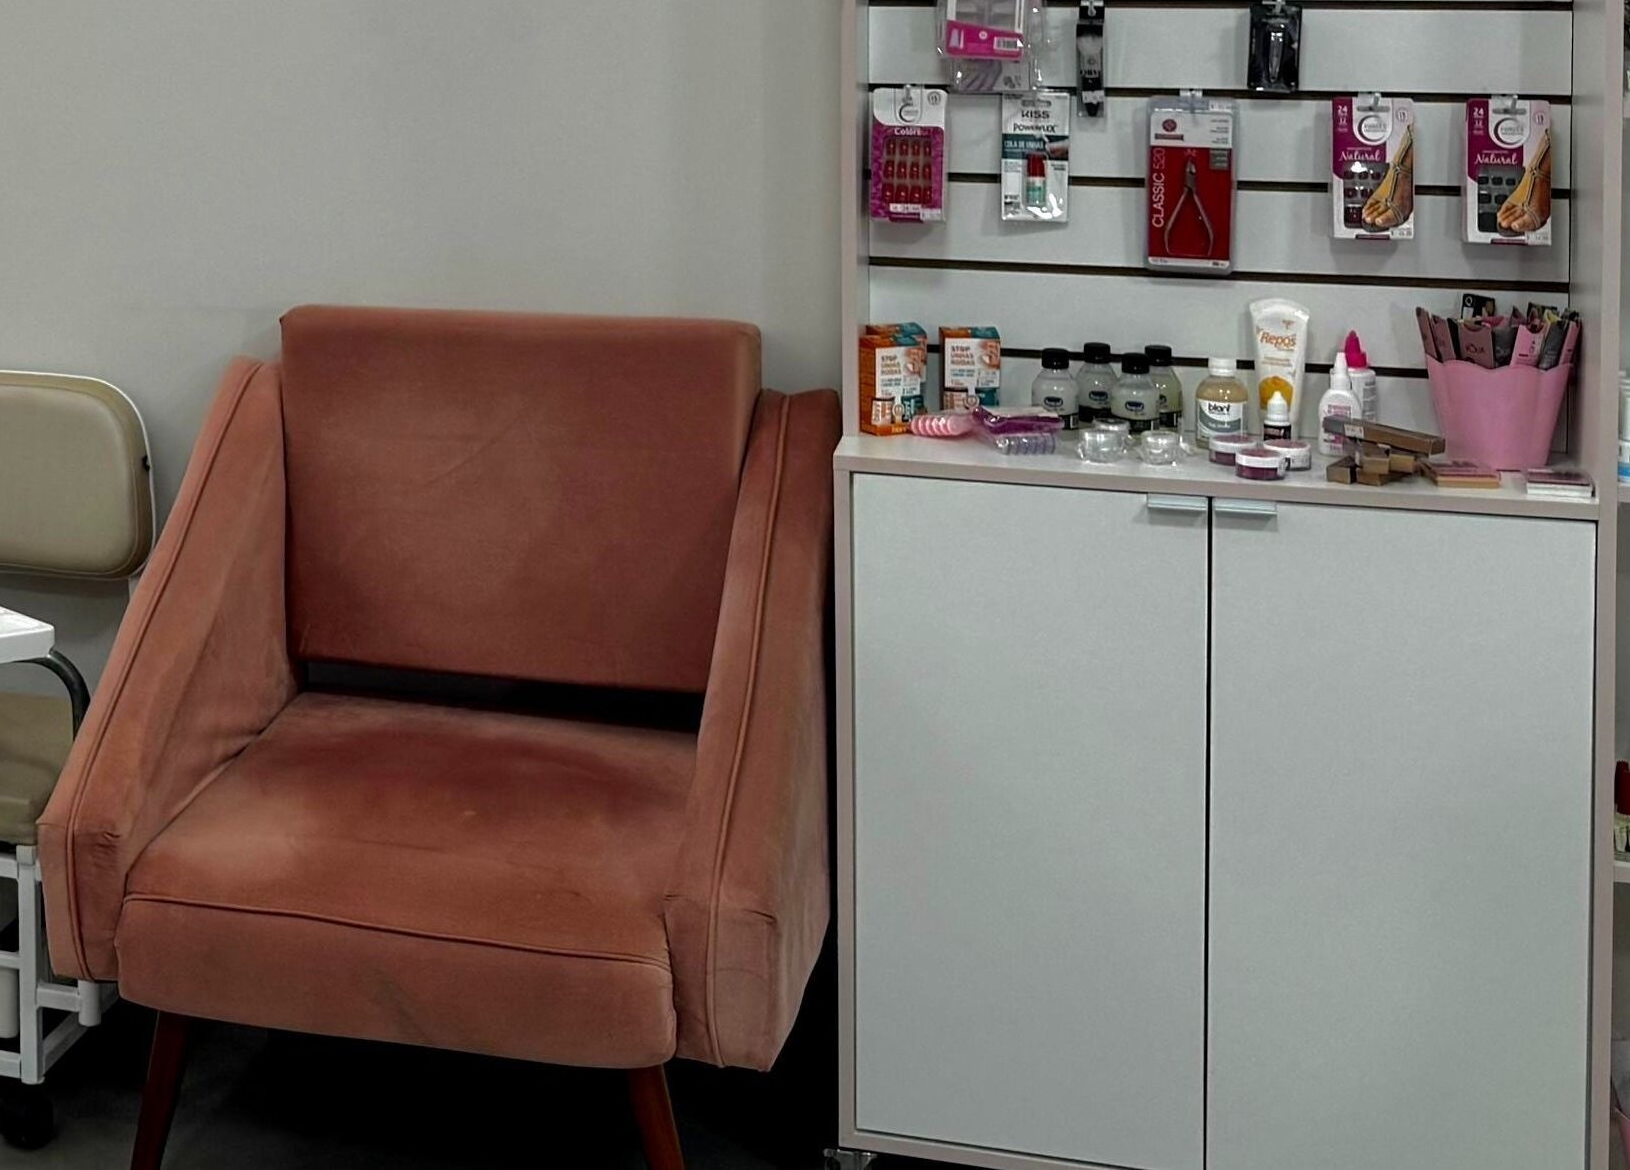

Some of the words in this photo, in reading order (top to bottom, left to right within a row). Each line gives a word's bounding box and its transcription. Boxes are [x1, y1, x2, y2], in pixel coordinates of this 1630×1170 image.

[1021, 110, 1050, 119] KISS
[1339, 150, 1382, 162] Natural
[1474, 152, 1518, 165] Natural
[1152, 173, 1165, 228] CLASSIC
